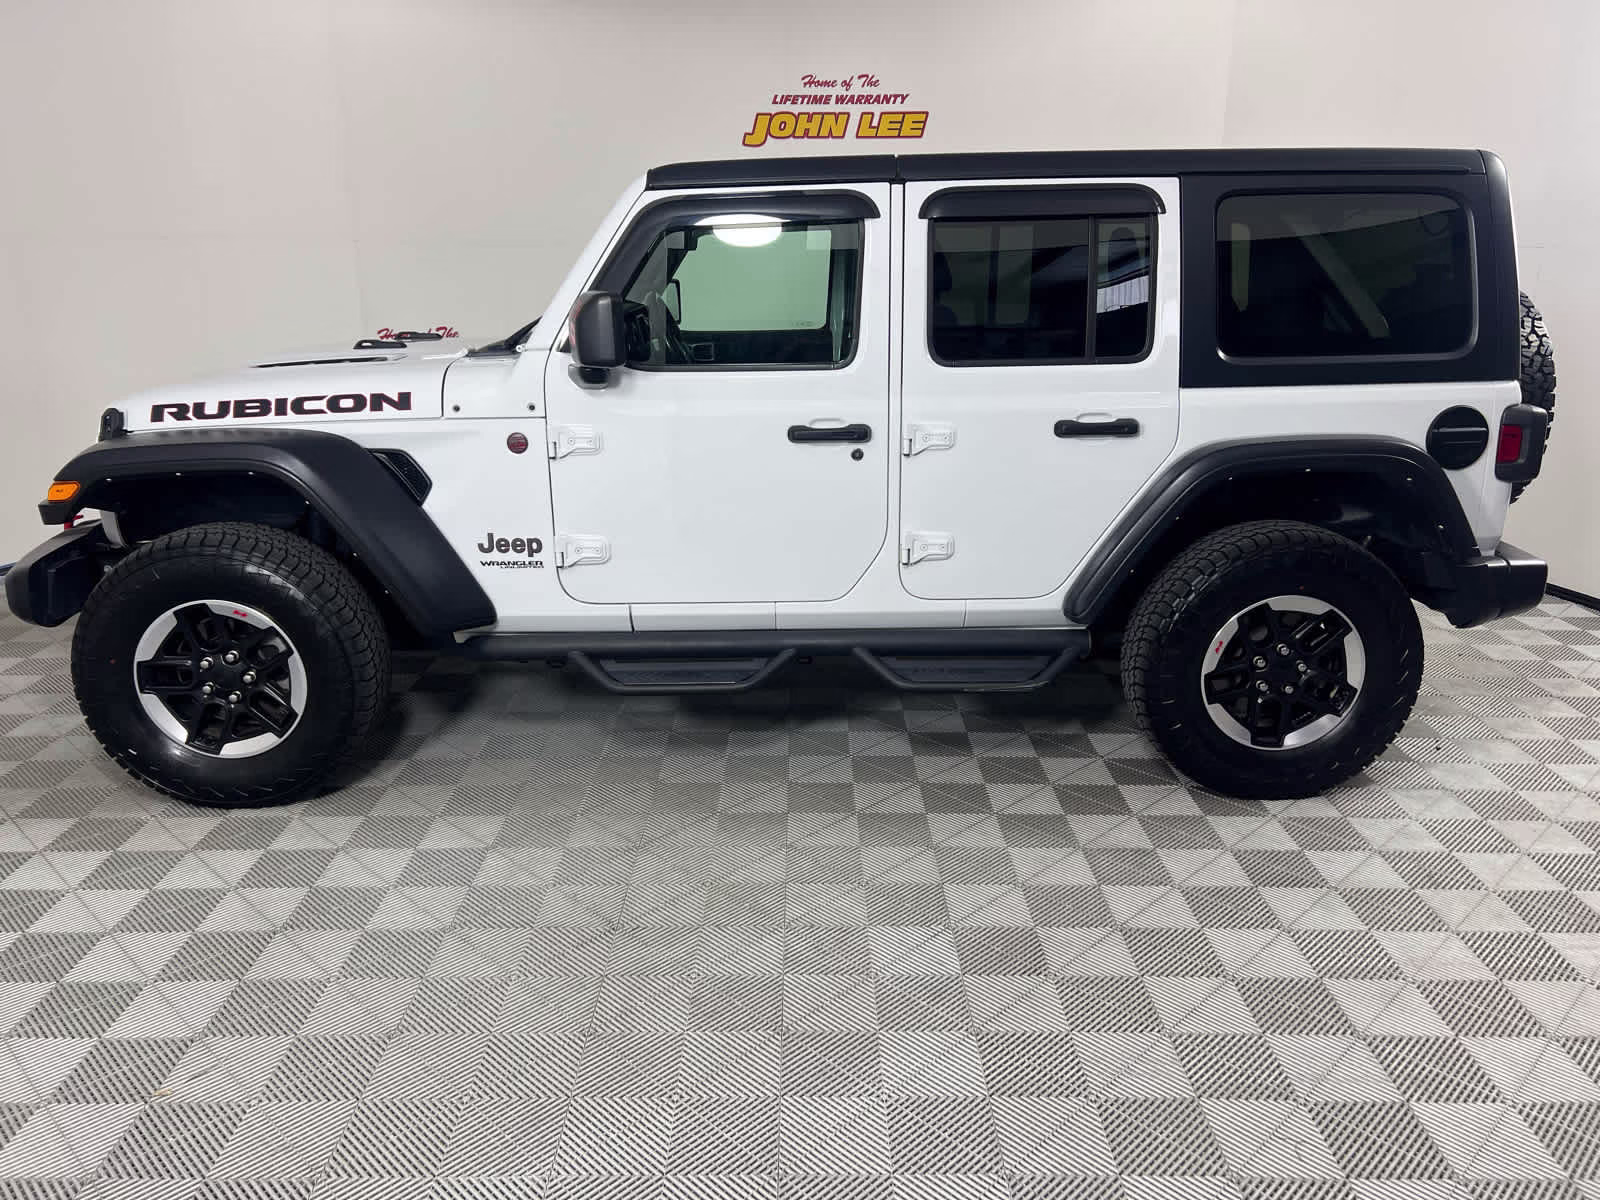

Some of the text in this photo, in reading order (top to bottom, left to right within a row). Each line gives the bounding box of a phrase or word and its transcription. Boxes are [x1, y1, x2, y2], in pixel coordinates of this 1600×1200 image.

[801, 74, 880, 91] Home of The
[772, 94, 909, 105] LIFETIME WARRANTY
[742, 111, 929, 147] JOHN LEE
[150, 391, 411, 423] RUBICON
[477, 532, 543, 557] Jeep
